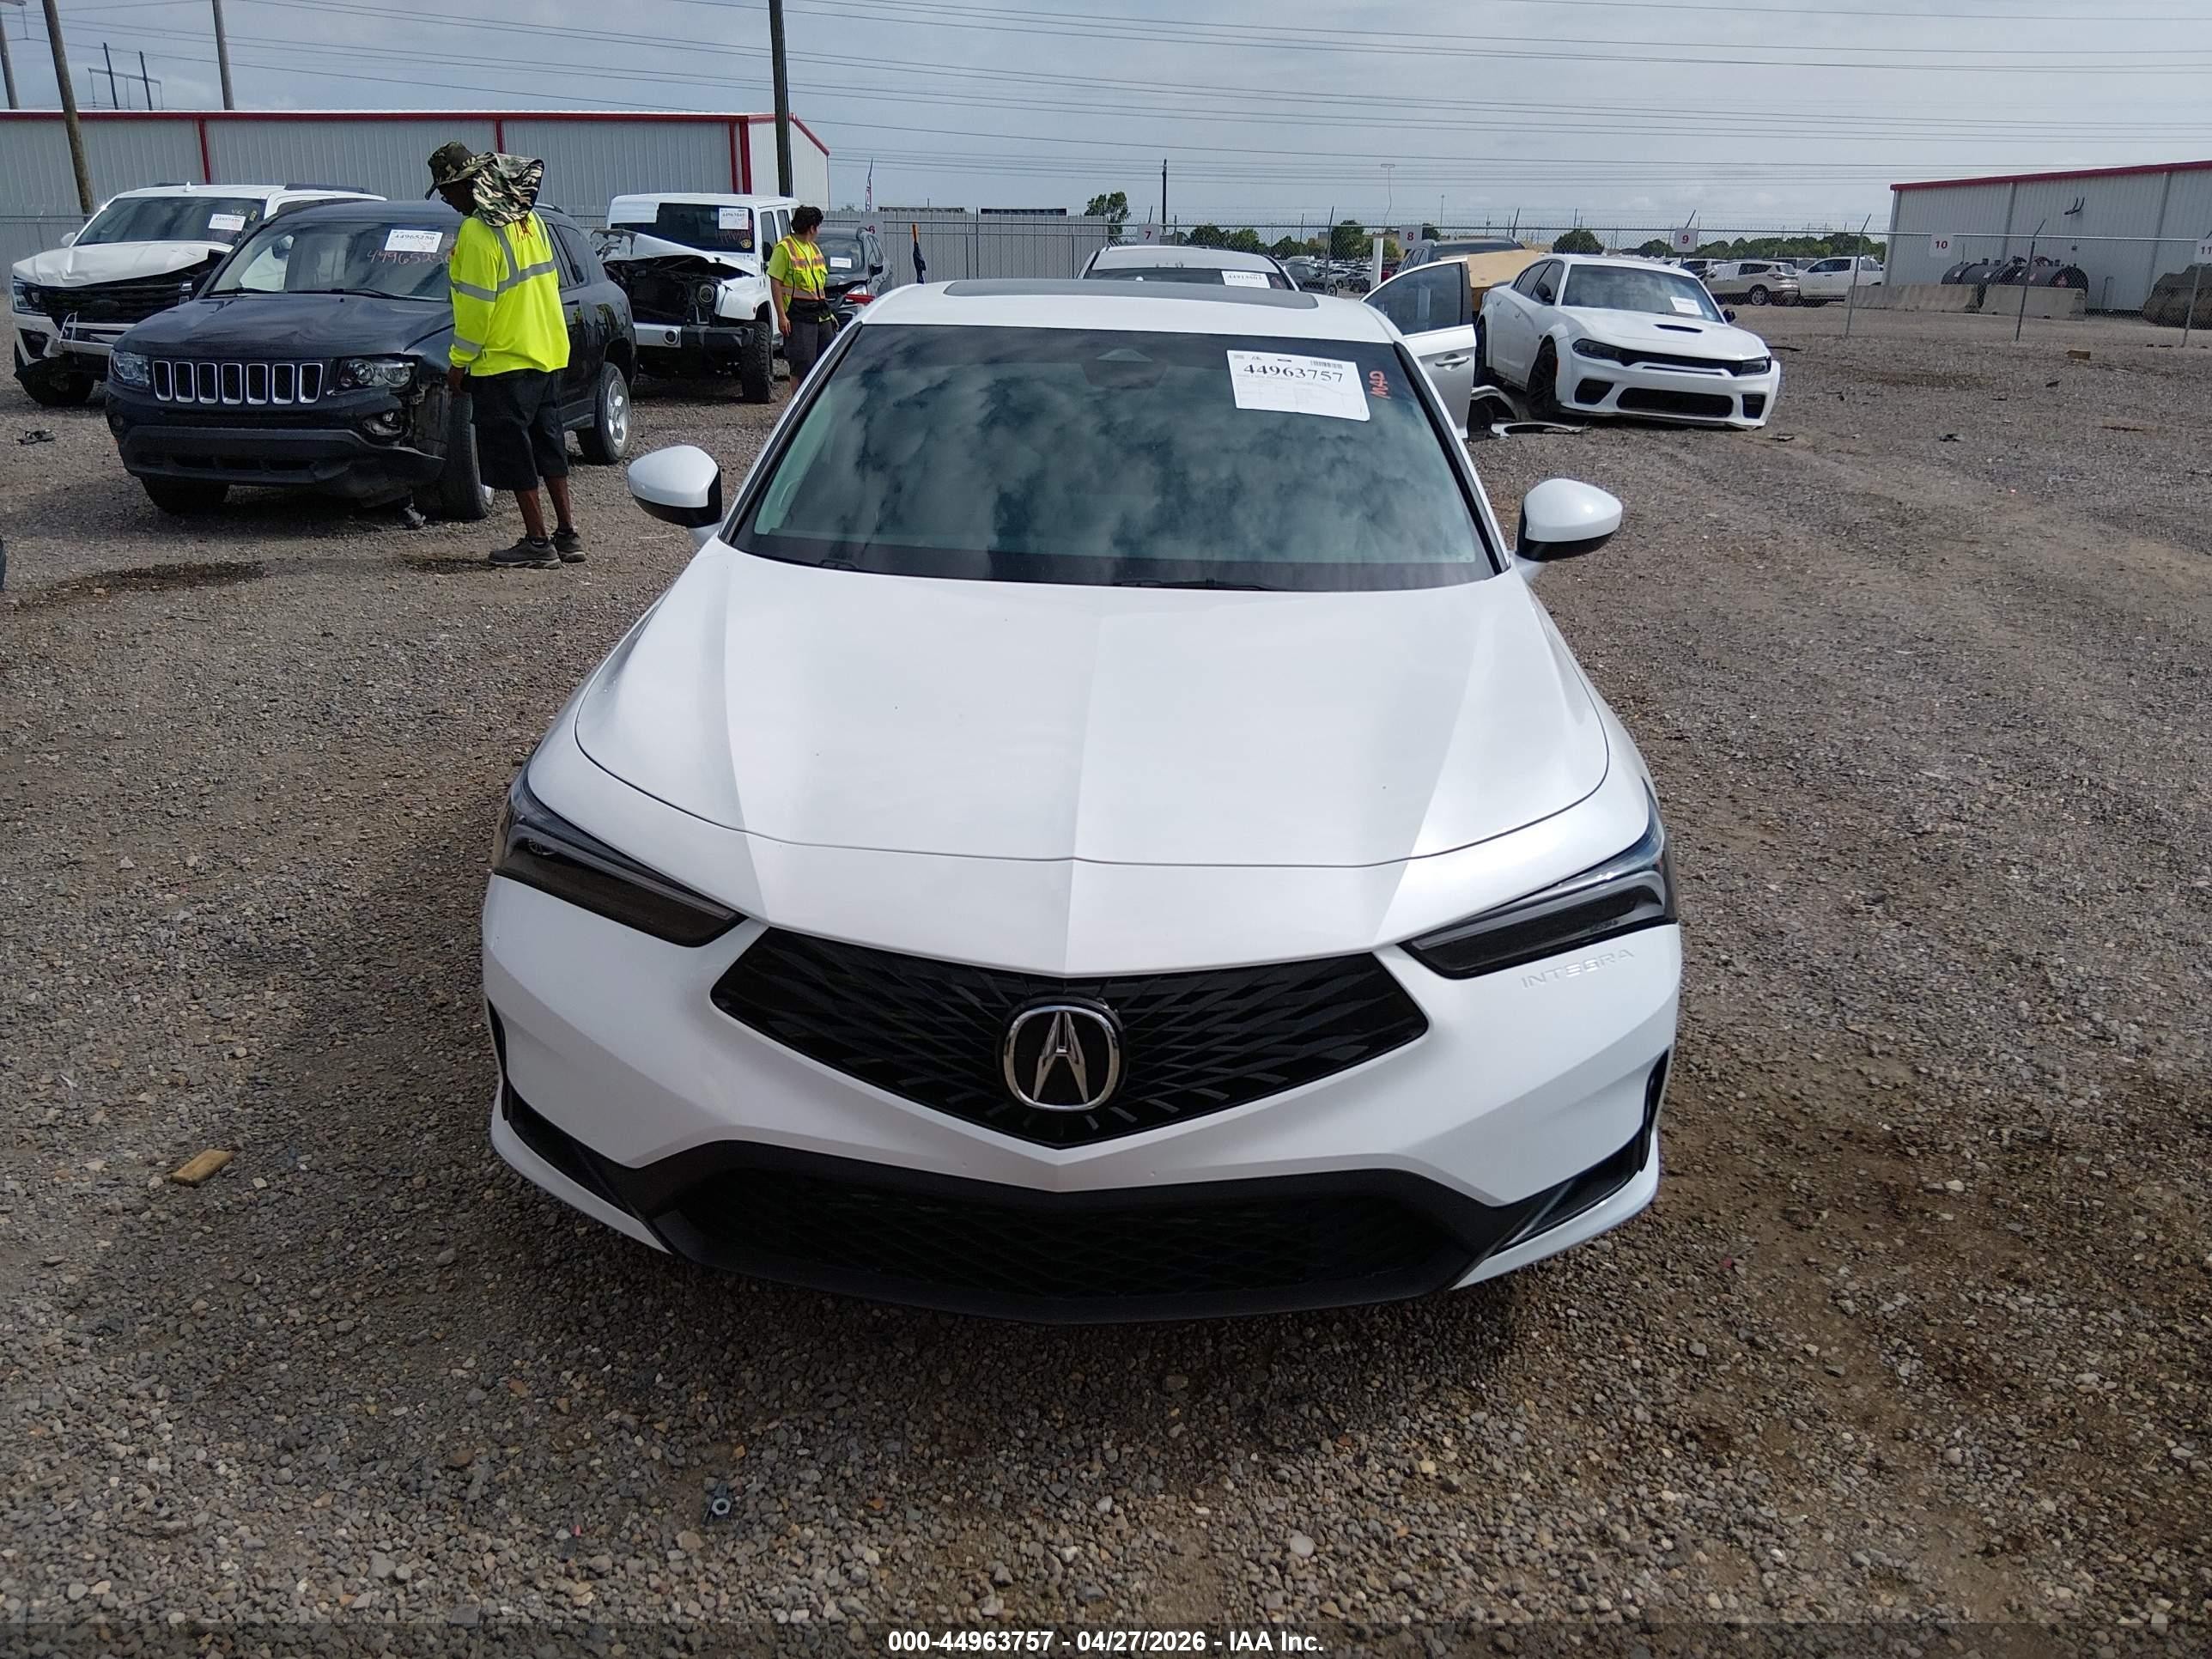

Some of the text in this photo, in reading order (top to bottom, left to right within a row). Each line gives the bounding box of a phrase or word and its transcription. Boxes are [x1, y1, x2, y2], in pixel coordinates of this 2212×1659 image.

[1145, 230, 1152, 240] 7
[1407, 232, 1414, 241] 8
[1681, 234, 1689, 245] 9
[1935, 240, 1948, 249] 10
[2201, 246, 2212, 255] 11
[1243, 363, 1343, 383] 44963757
[1521, 949, 1635, 988] INTEGRA
